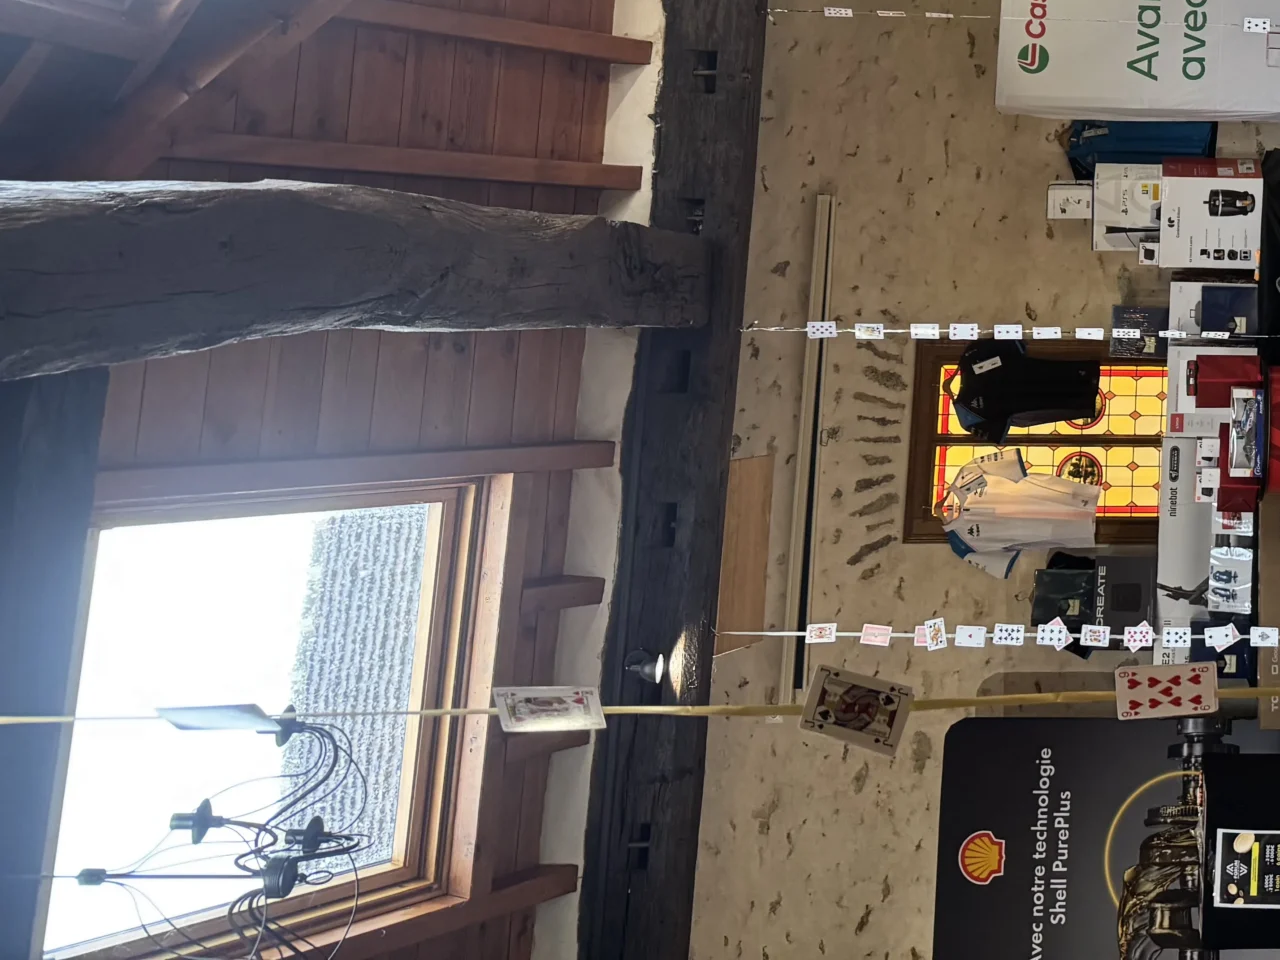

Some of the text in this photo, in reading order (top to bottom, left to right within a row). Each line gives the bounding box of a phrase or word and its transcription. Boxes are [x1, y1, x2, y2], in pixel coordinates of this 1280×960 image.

[1168, 487, 1177, 517] ninebot
[1095, 565, 1106, 627] CREATE
[804, 719, 815, 728] J
[1271, 695, 1279, 712] TC
[1031, 747, 1055, 859] technologie
[1049, 791, 1071, 925] Shell PurePlus
[1030, 865, 1045, 917] notre
